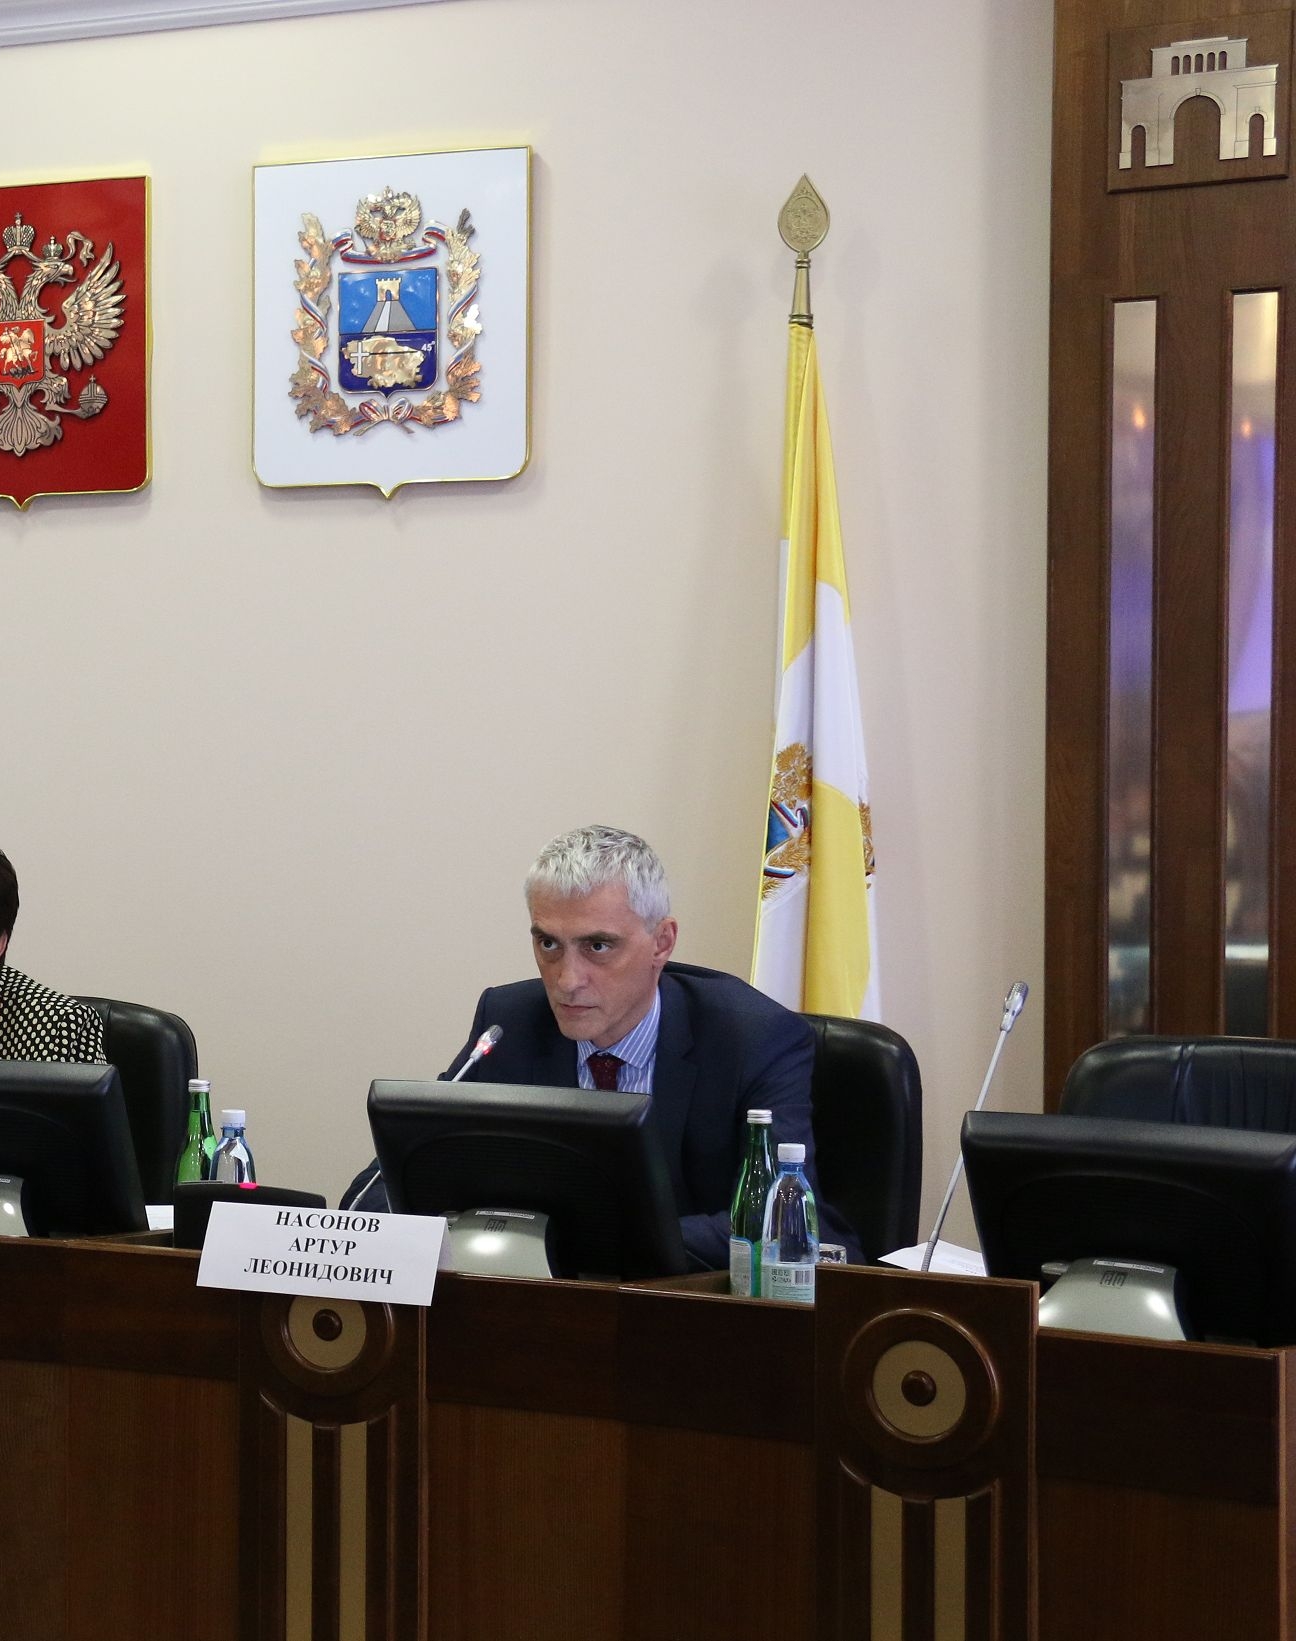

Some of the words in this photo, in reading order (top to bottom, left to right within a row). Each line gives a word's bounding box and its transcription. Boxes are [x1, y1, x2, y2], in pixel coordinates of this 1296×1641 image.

[275, 1210, 381, 1233] НАСОНОВ
[288, 1237, 357, 1256] АРТУР
[243, 1257, 393, 1285] ЛЕОНИДОВИЧ
